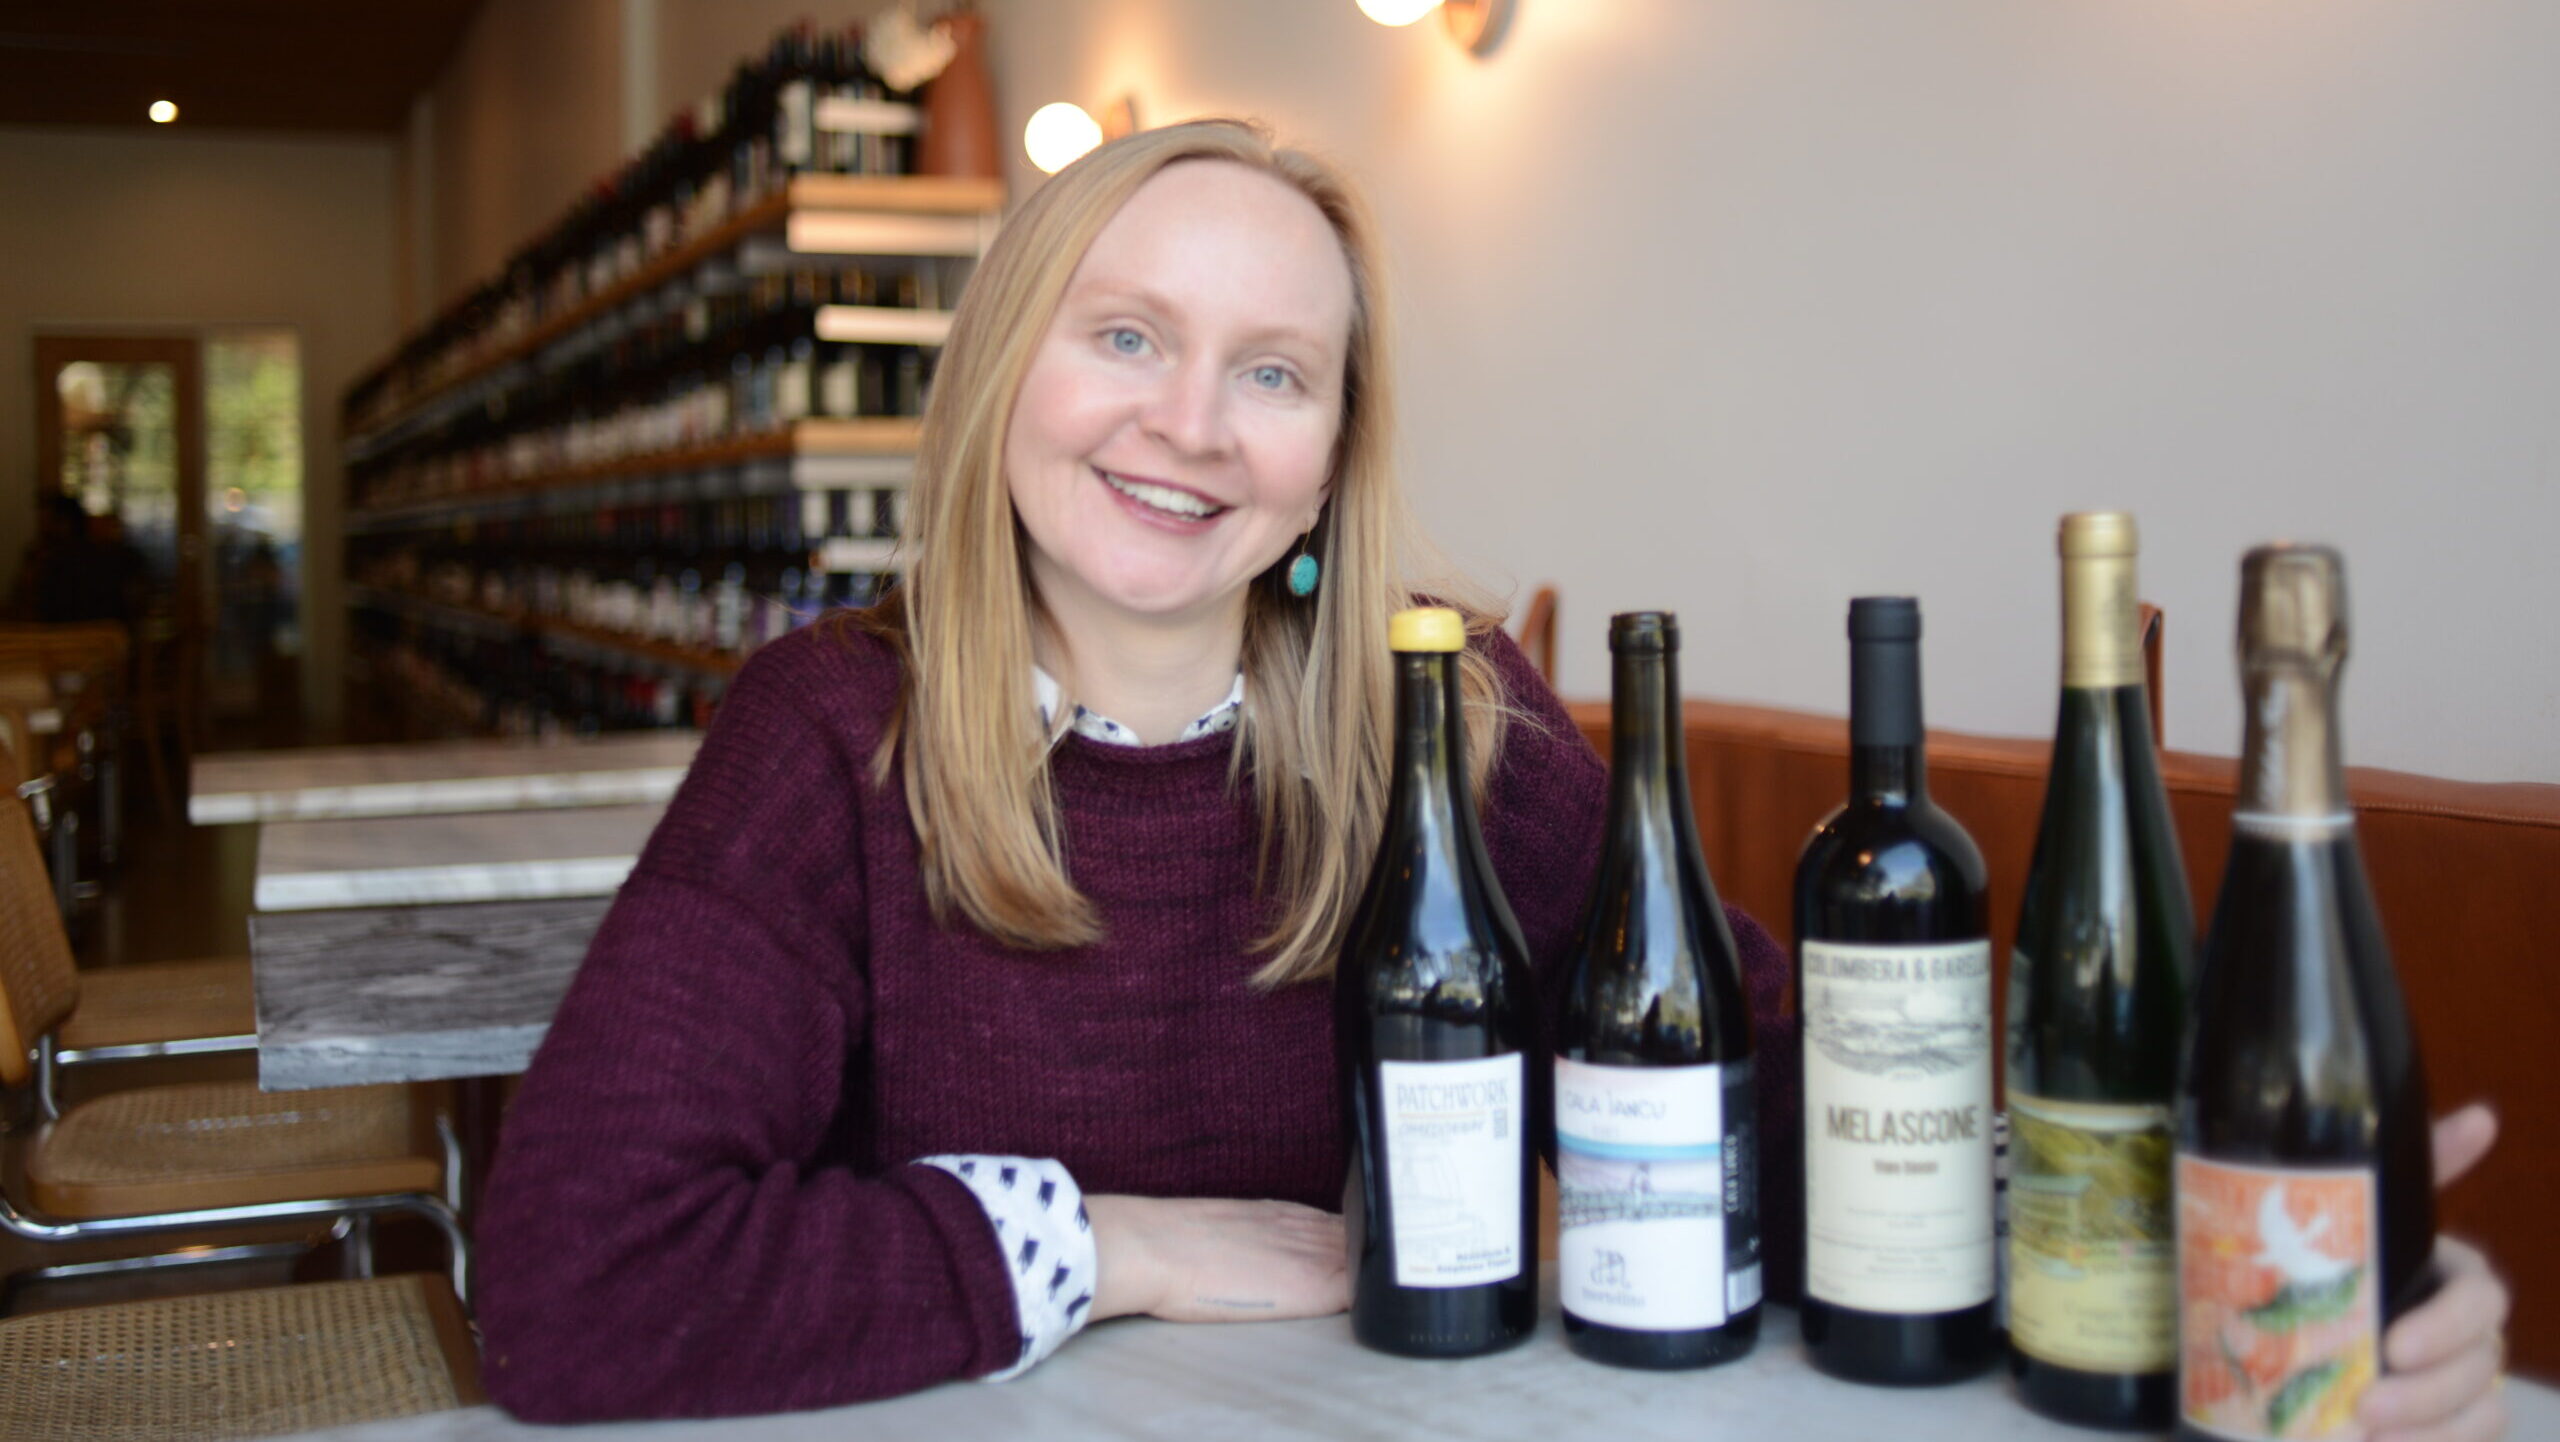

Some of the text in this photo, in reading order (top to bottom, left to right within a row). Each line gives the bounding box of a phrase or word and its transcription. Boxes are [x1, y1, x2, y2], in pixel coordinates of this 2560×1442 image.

[1914, 957, 1926, 983] &
[1396, 1078, 1509, 1111] PATCHWORK
[1566, 1088, 1600, 1115] CALA
[1826, 1103, 1980, 1146] MELASCONE
